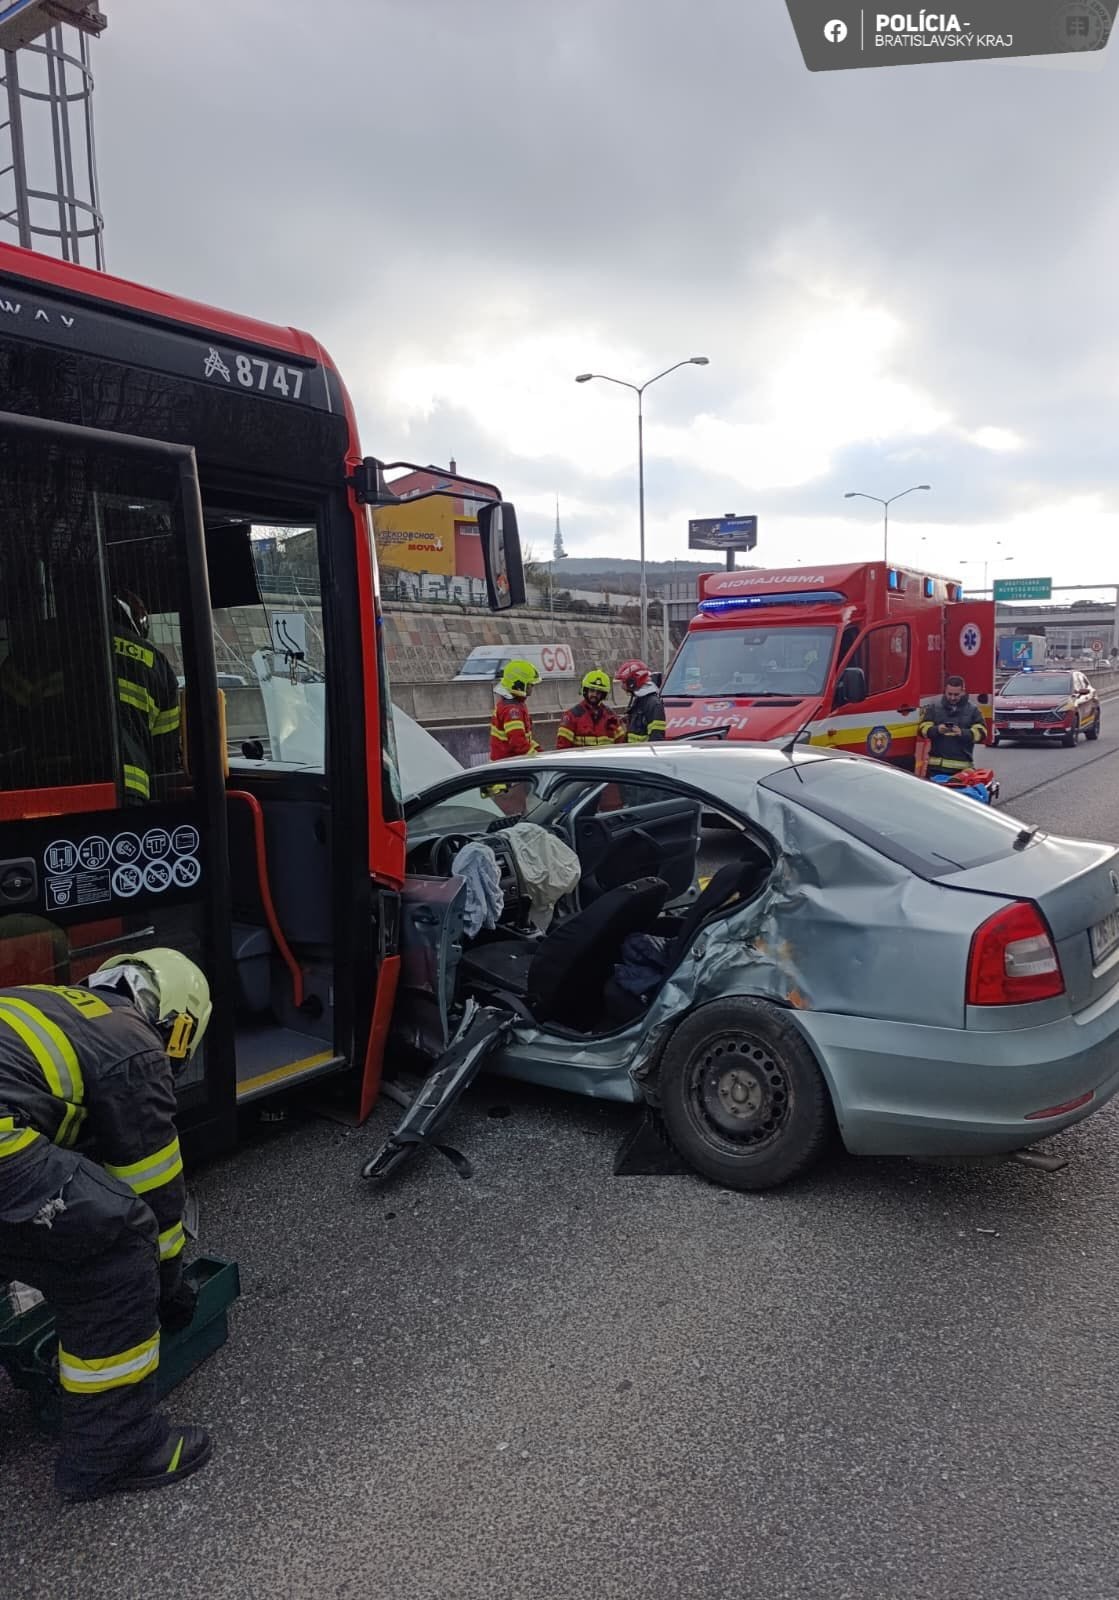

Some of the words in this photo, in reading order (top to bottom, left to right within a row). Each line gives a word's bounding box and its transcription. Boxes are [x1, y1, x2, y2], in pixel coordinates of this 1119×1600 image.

[235, 354, 304, 399] 8747
[541, 646, 574, 672] GO!
[666, 713, 749, 730] HASIČI
